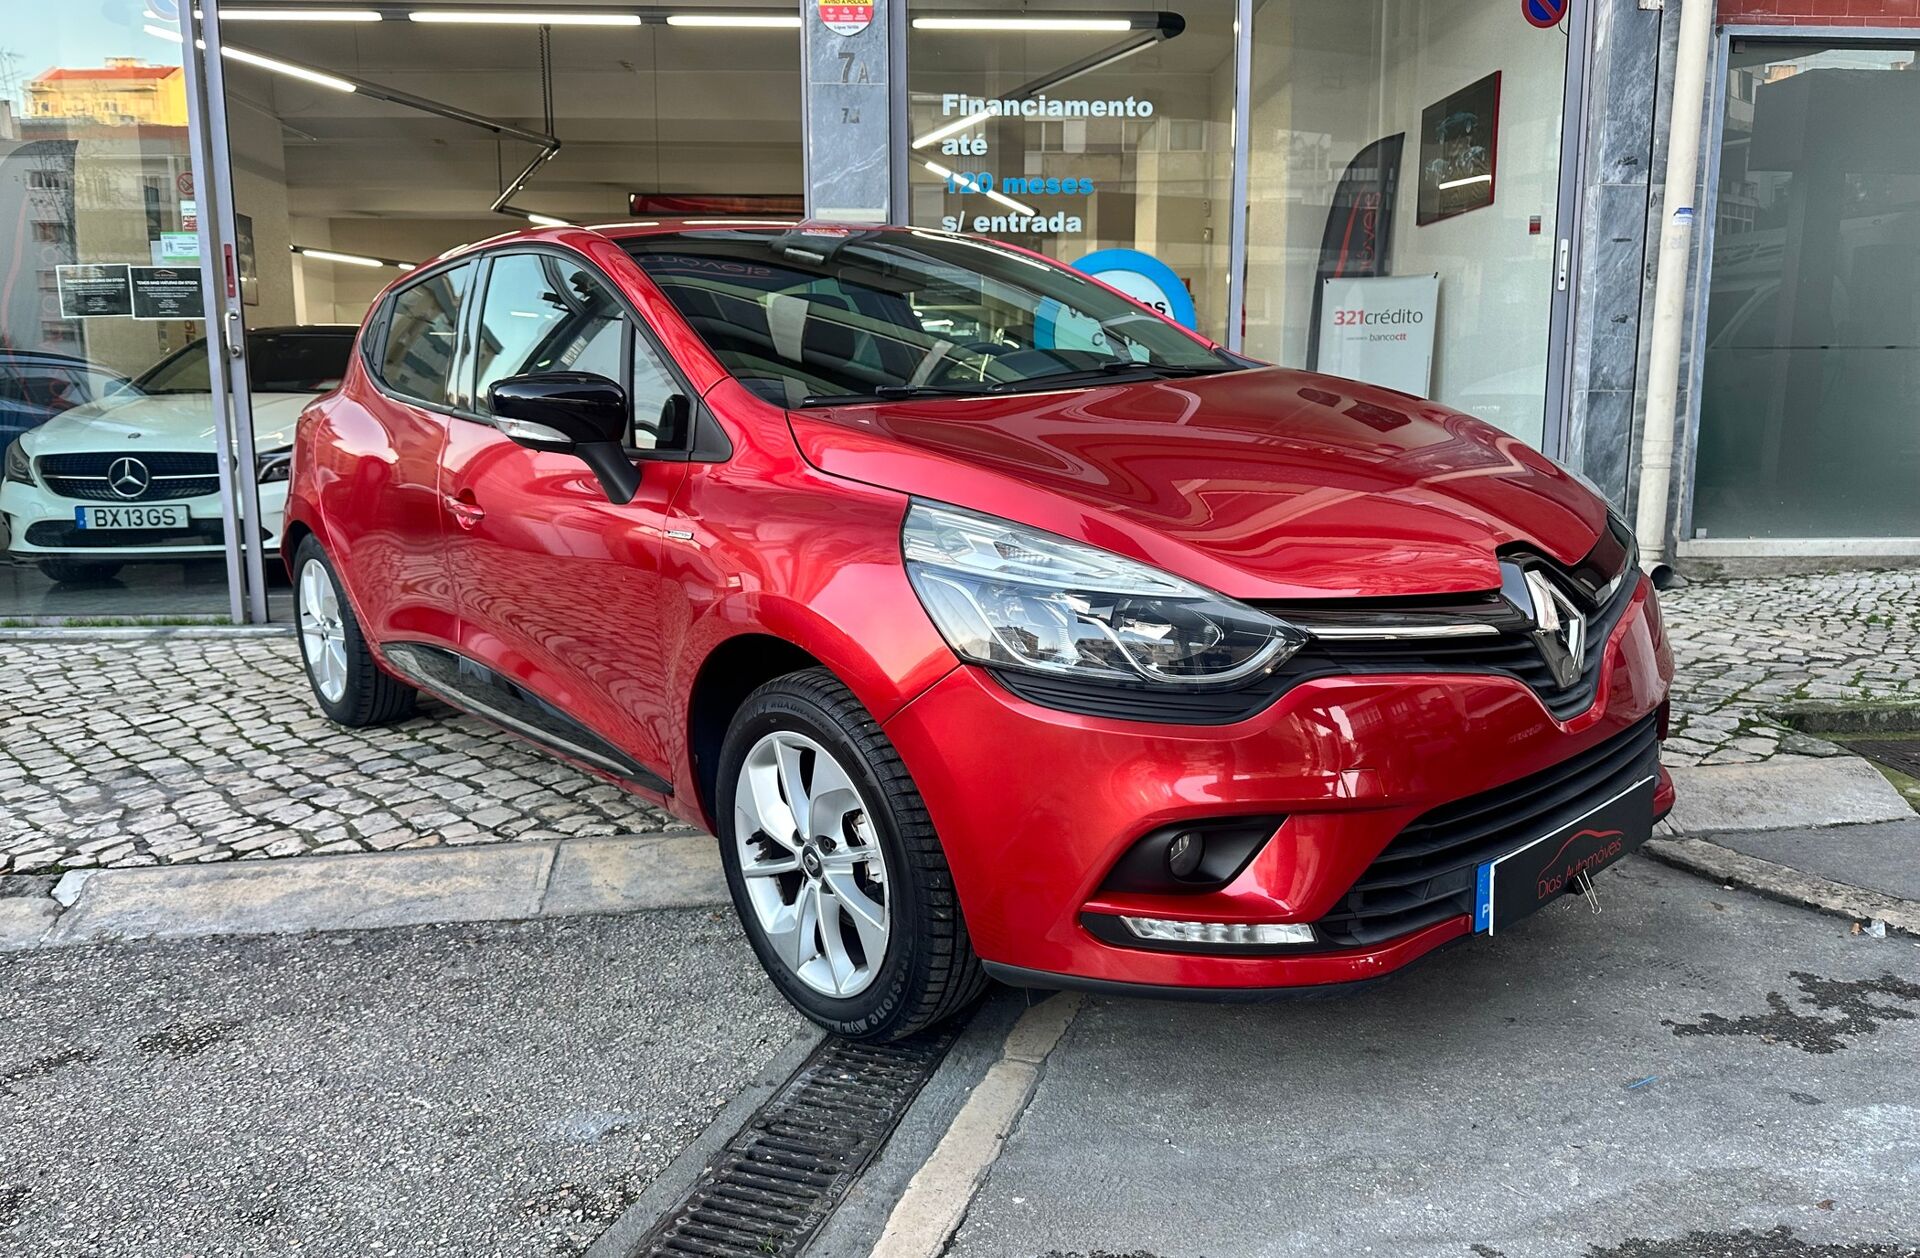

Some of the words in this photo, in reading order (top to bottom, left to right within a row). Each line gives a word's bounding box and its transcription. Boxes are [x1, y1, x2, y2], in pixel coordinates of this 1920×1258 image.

[942, 94, 1154, 117] Financiamento
[941, 133, 988, 156] até
[943, 172, 993, 195] 120
[1003, 177, 1095, 195] meses
[941, 210, 966, 233] s/
[973, 211, 1082, 233] entrada
[1334, 308, 1423, 325] 321crédito
[1538, 874, 1563, 899] Dias
